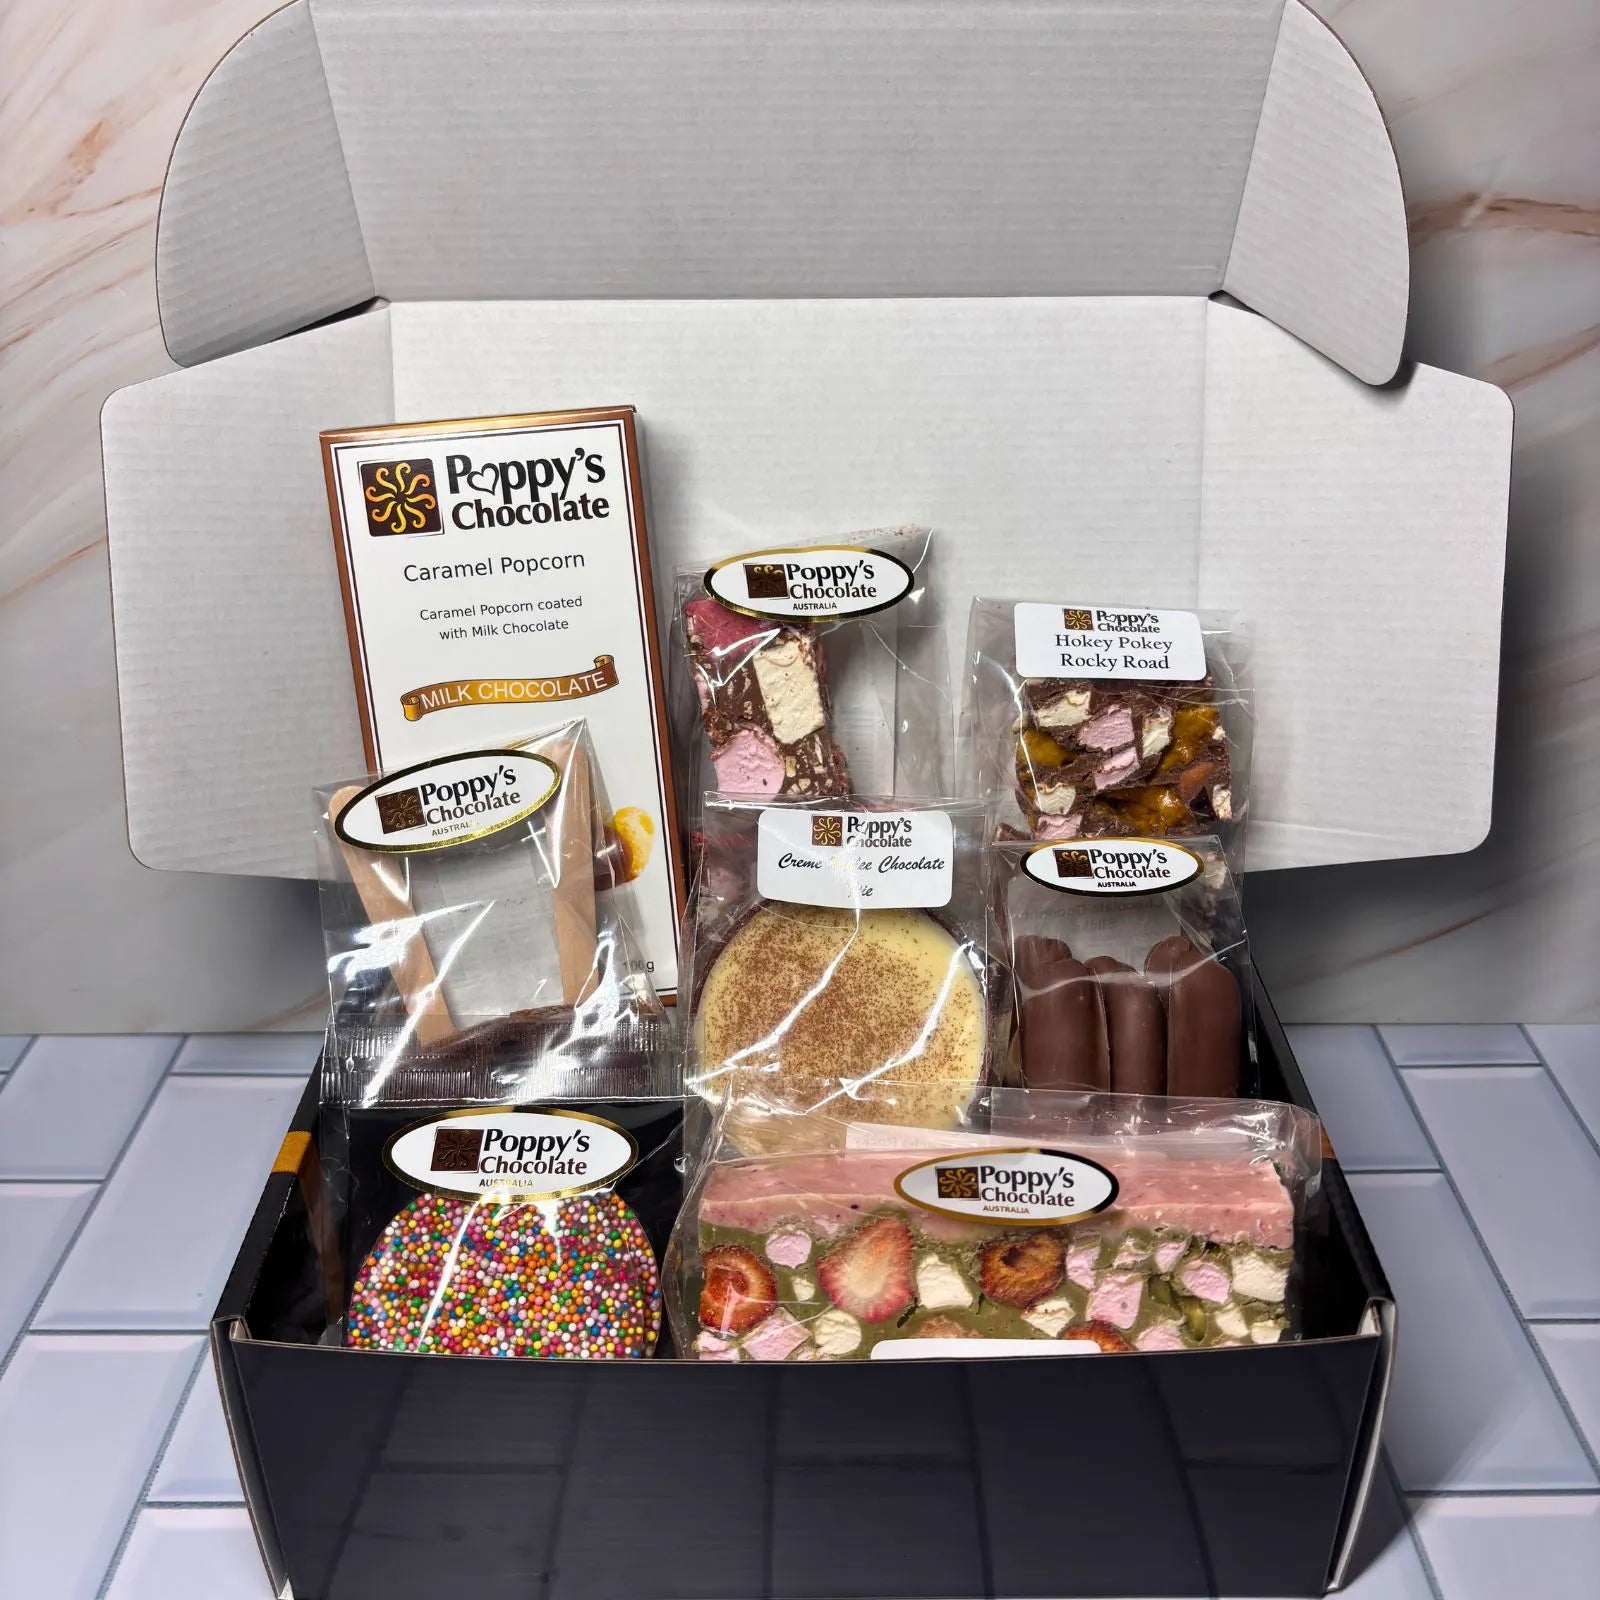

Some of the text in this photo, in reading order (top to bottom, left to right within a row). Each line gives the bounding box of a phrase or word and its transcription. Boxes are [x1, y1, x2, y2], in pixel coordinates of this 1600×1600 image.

[445, 447, 606, 504] Poppy's
[451, 492, 610, 530] Chocolate
[403, 552, 585, 582] Caramel Popcorn
[786, 559, 875, 587] Poppy's
[789, 583, 877, 600] Chocolate
[419, 595, 583, 621] Caramel Popcorn coated
[792, 602, 838, 611] AUSTRALIA
[1096, 610, 1159, 626] Poppy's
[1097, 622, 1161, 634] Chocolate
[439, 619, 569, 640] with Milk Chocolate
[1055, 634, 1173, 654] Hokey Pokey
[1061, 653, 1170, 671] Rocky Road
[420, 671, 608, 711] MILK CHOCOLATE
[420, 765, 517, 806] Poppy's
[426, 791, 521, 825] Chocolate
[431, 819, 480, 837] AUSTRAL
[778, 852, 823, 869] Creme
[877, 855, 945, 873] Chocolate
[1089, 848, 1167, 870] Poppy's
[1093, 866, 1171, 879] Chocolate
[848, 882, 873, 898] ie
[483, 1128, 590, 1161] Poppy's
[480, 1155, 587, 1175] Chocolate
[980, 1165, 1075, 1194] Poppy's
[981, 1187, 1075, 1207] Chocolate
[982, 1205, 1030, 1214] AUSTRALIA
